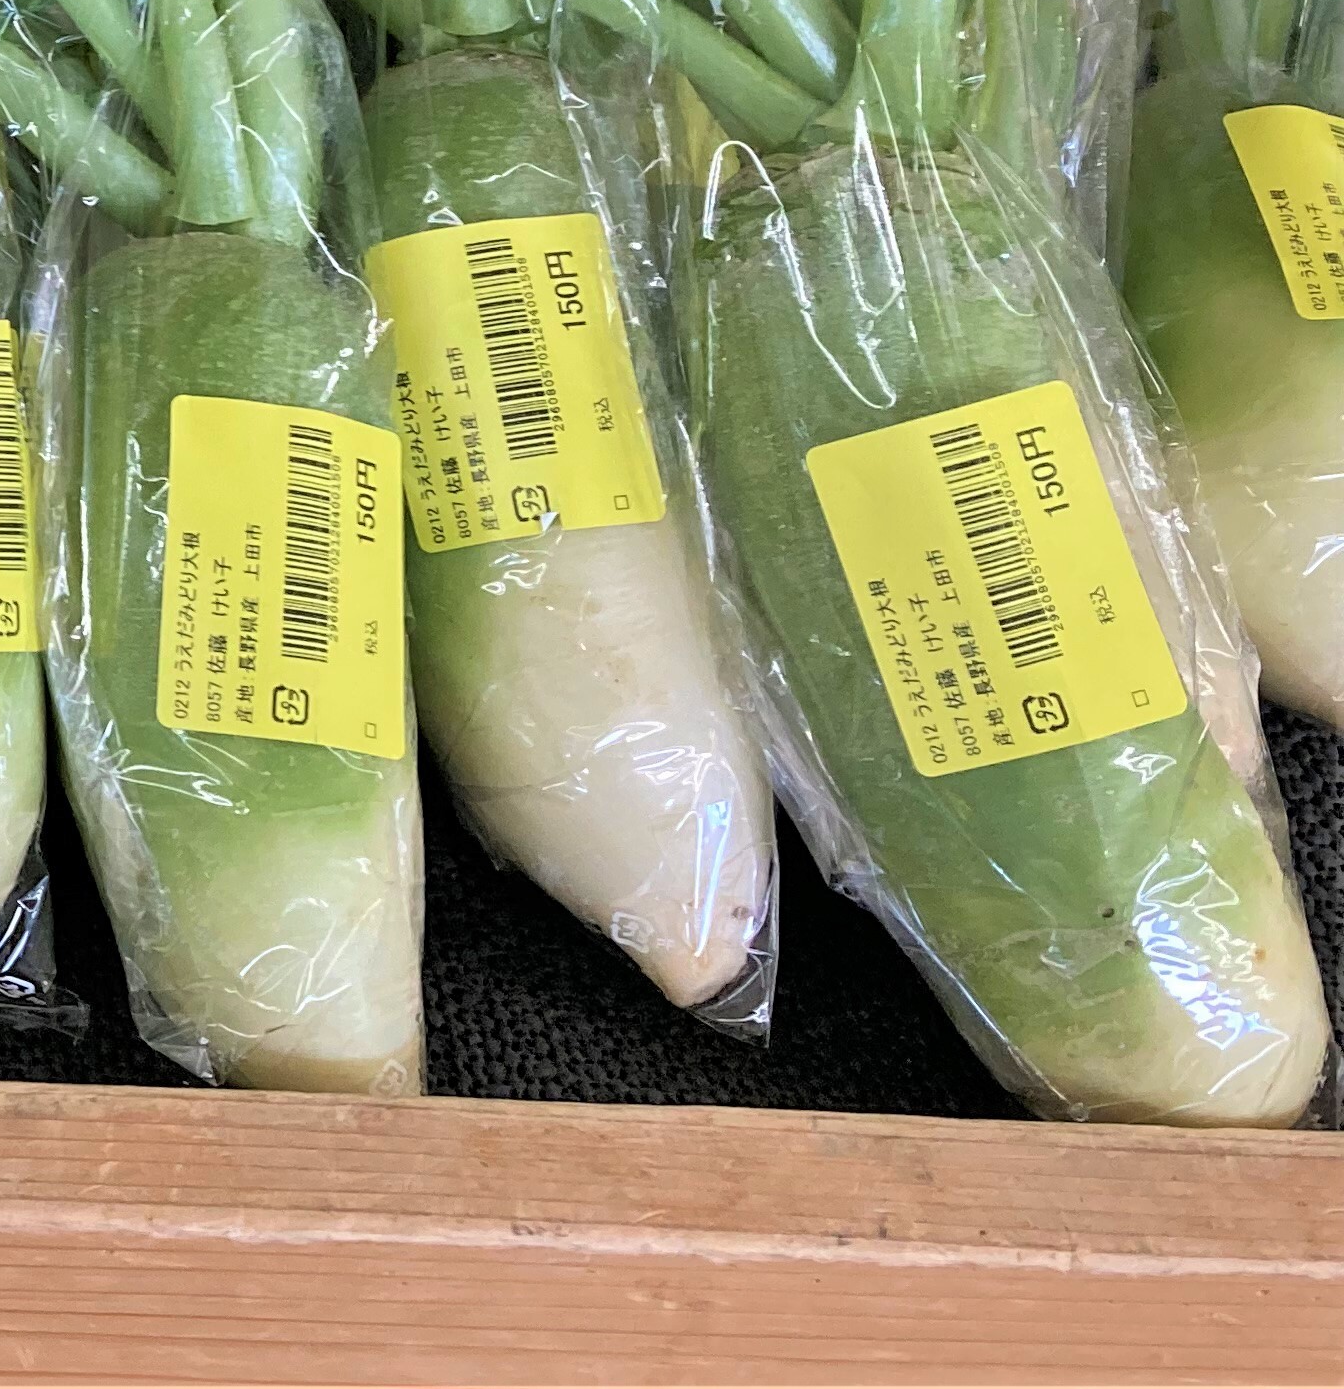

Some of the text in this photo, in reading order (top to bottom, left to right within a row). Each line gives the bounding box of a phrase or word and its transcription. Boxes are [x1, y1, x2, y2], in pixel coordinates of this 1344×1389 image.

[1268, 188, 1327, 311] 0212 うえだみどり大根
[1303, 202, 1332, 241] けい子
[543, 250, 586, 329] 150円
[445, 346, 471, 398] 上田市
[516, 256, 565, 431] 29608057021284001508
[395, 370, 446, 544] 0212 うえだみどり大根
[592, 396, 614, 432] 税込
[355, 457, 377, 542] 150円
[424, 385, 472, 539] 8057 佐藤 けい子
[1015, 425, 1069, 515] 150円
[243, 524, 262, 580] 上田市
[925, 549, 960, 604] 上田市
[987, 442, 1064, 631] 29608057021284001508
[173, 531, 200, 719] 0212 うえだみどり大根
[205, 556, 232, 722] 8057 佐藤 けい子
[364, 619, 378, 655] 税込
[1088, 584, 1116, 624] 税込
[867, 577, 948, 764] 0212 うえだみどり大根
[907, 592, 982, 756] 8057 佐藤 けい子
